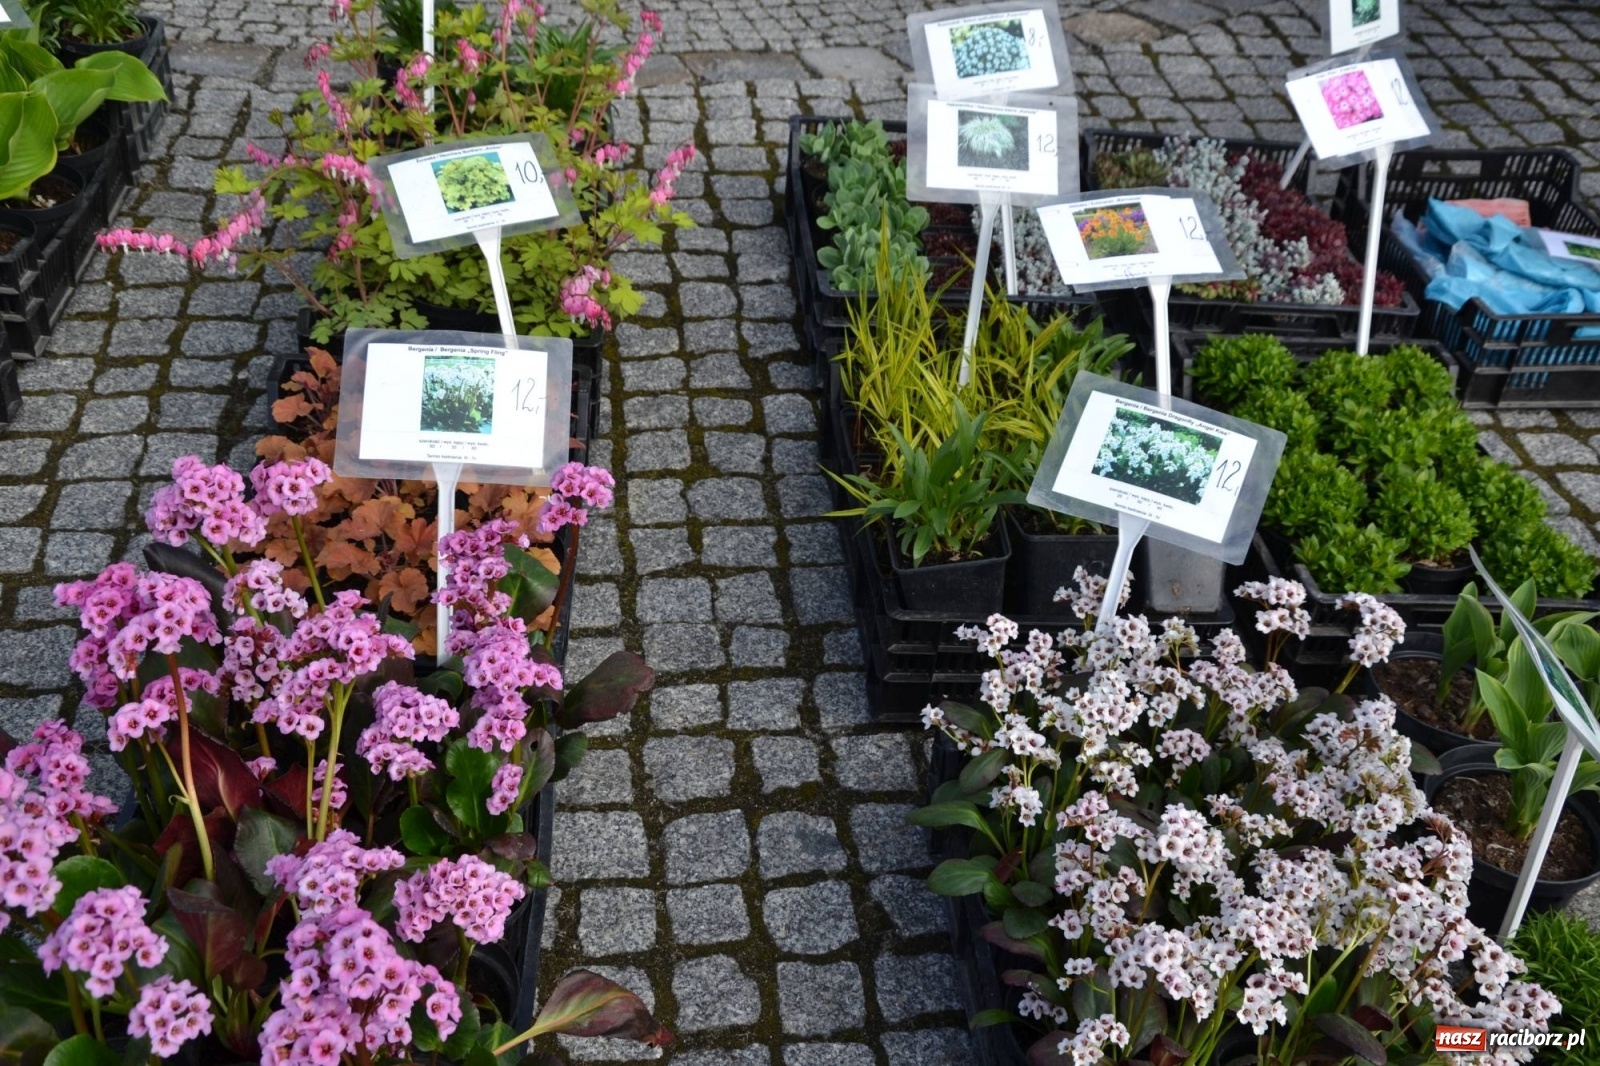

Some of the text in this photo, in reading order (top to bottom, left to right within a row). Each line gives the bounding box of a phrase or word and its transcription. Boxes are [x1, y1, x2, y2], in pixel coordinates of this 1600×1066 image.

[408, 345, 434, 353] Bergenia
[440, 346, 466, 354] Bergenia
[1115, 398, 1139, 410] Bergenia
[1143, 405, 1168, 417] Bergenia
[1168, 411, 1195, 426] Dragonfly
